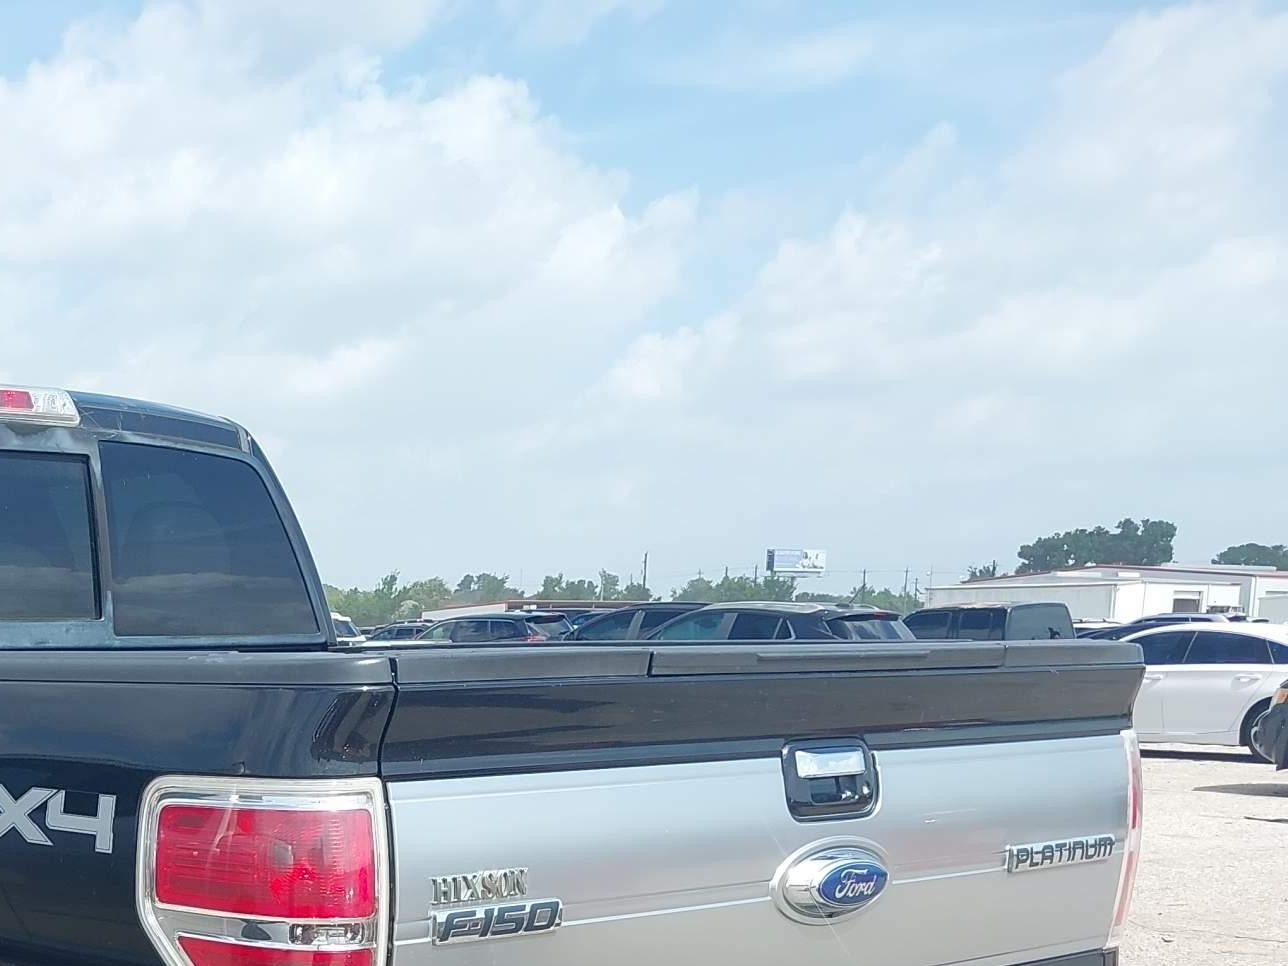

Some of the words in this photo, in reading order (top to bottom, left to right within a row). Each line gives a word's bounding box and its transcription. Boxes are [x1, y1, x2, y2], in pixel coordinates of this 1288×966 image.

[1015, 836, 1114, 870] PLATINUM
[429, 868, 528, 905] HIXSON
[835, 869, 878, 898] Ford
